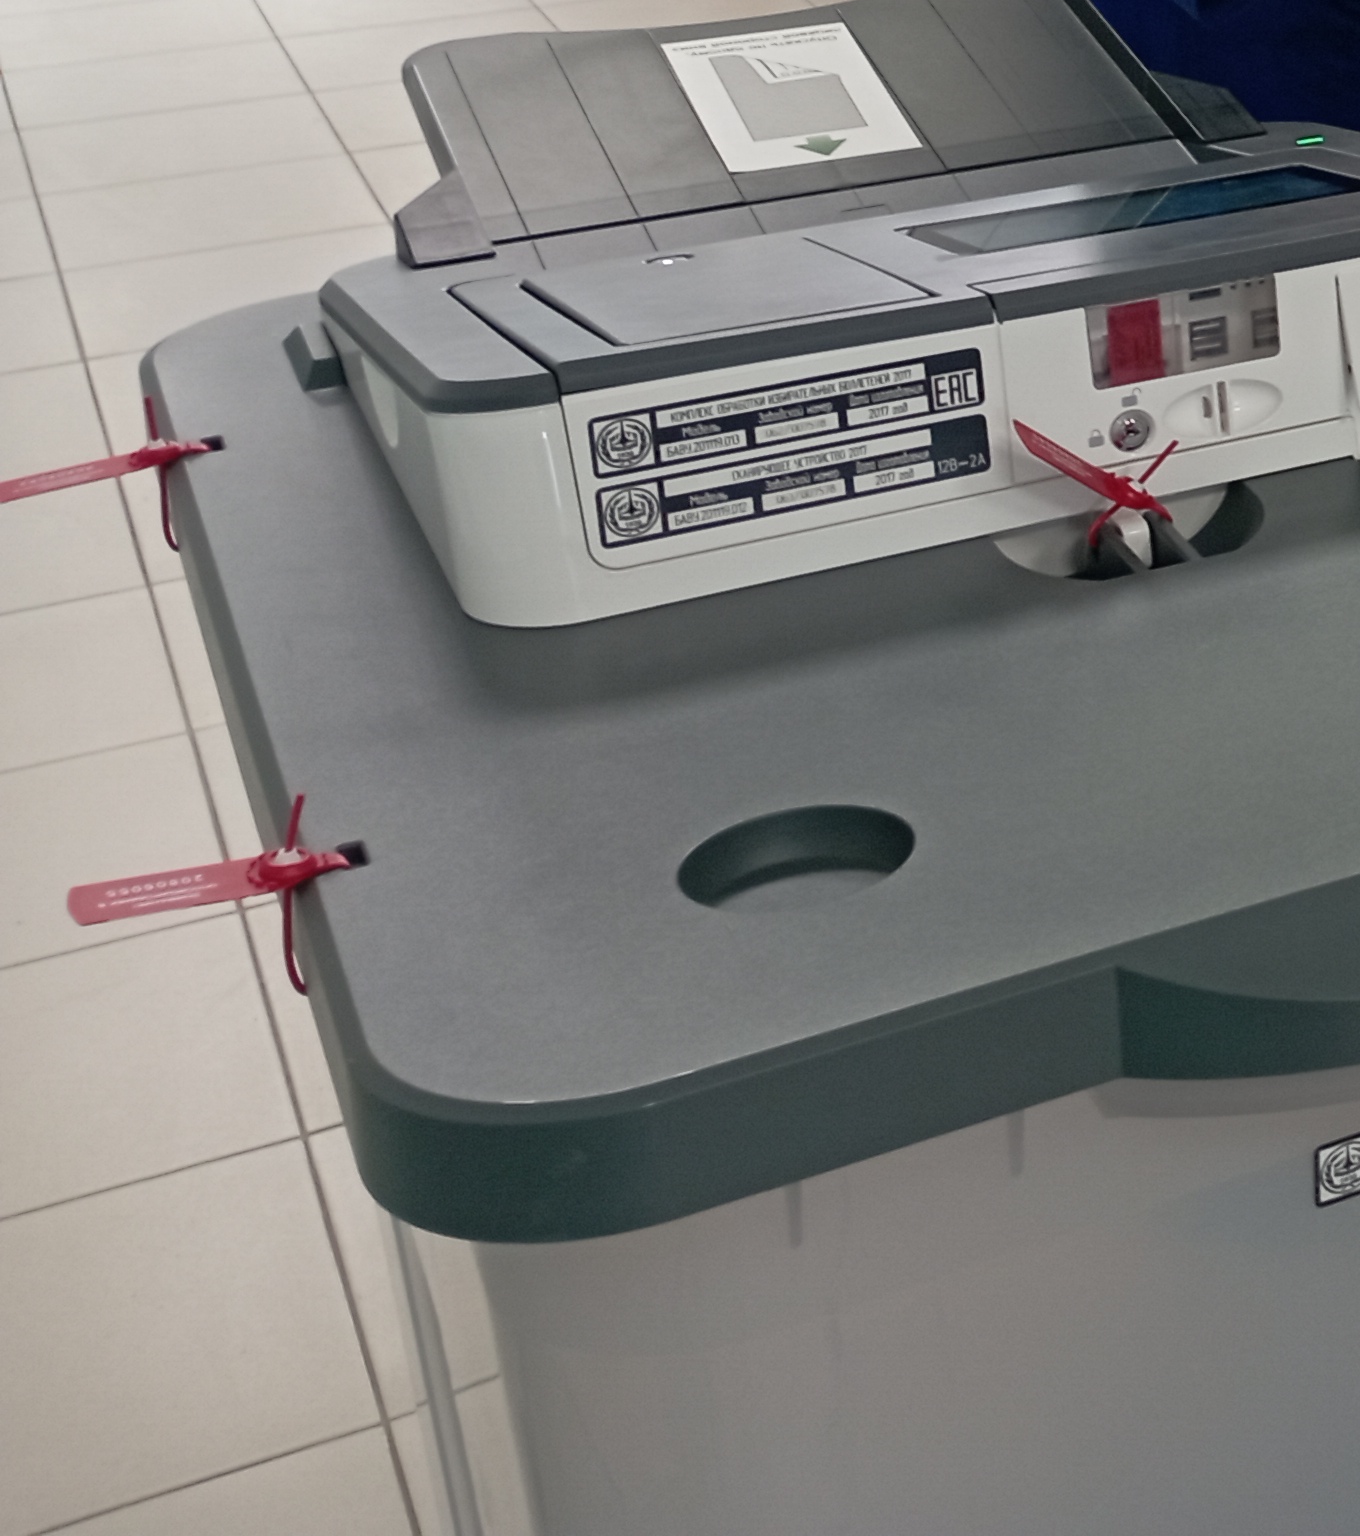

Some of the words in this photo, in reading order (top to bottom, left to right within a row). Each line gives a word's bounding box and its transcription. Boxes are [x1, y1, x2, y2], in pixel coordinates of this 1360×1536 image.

[670, 405, 713, 424] КОМПЛЕКС
[716, 397, 766, 415] ОБРАБОТКИ
[767, 383, 837, 405] ИЗБИРАТЕЛЬНЫХ
[838, 372, 891, 392] БЮЛЛЕТЕНЕЙ
[892, 368, 912, 382] 2017
[933, 370, 977, 408] EAC
[868, 405, 889, 419] 2017
[793, 448, 846, 469] УСТРОЙСТВО
[848, 444, 868, 459] 2017
[875, 471, 896, 486] 2017
